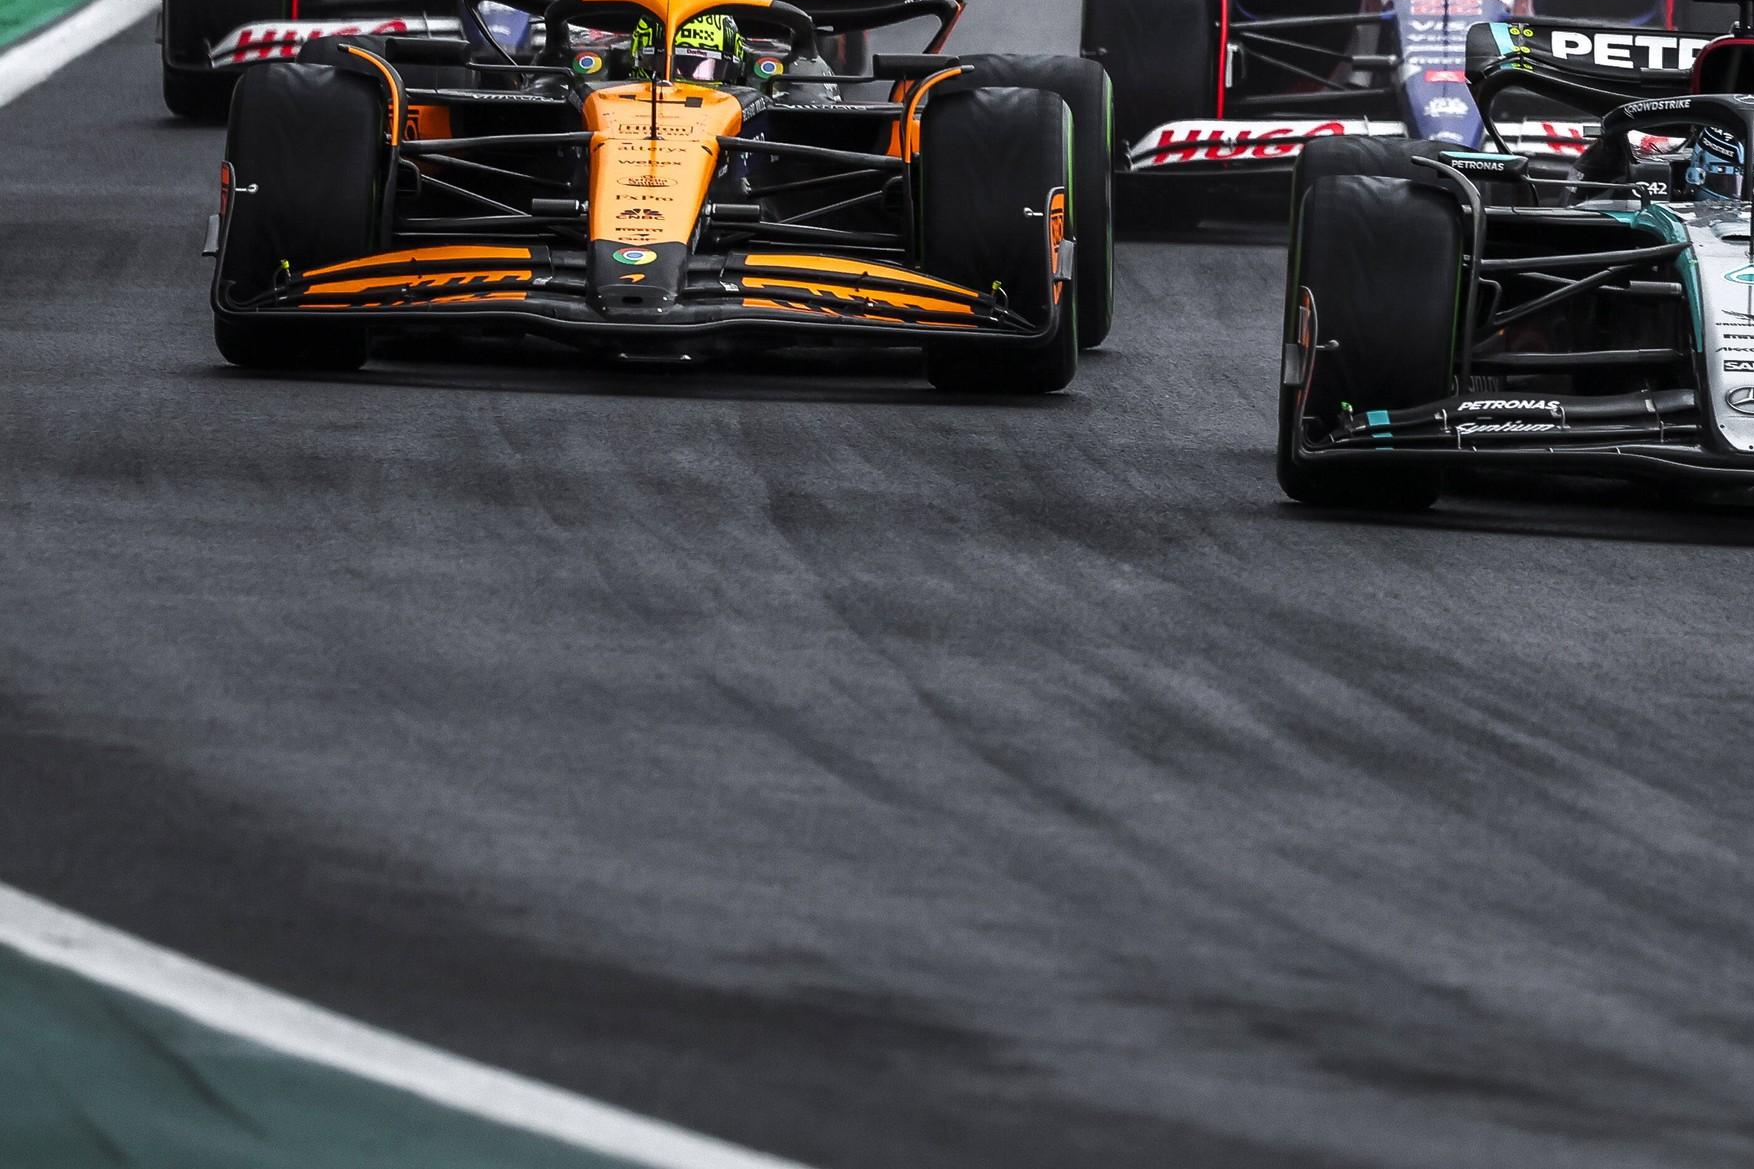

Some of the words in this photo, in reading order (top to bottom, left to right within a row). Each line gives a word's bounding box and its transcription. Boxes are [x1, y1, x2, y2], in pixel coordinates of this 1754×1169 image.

[1626, 98, 1692, 114] CROWDSTRIKE
[1451, 159, 1504, 172] PETRONAS
[615, 194, 674, 202] FxPro
[1457, 399, 1561, 413] PETRONAS
